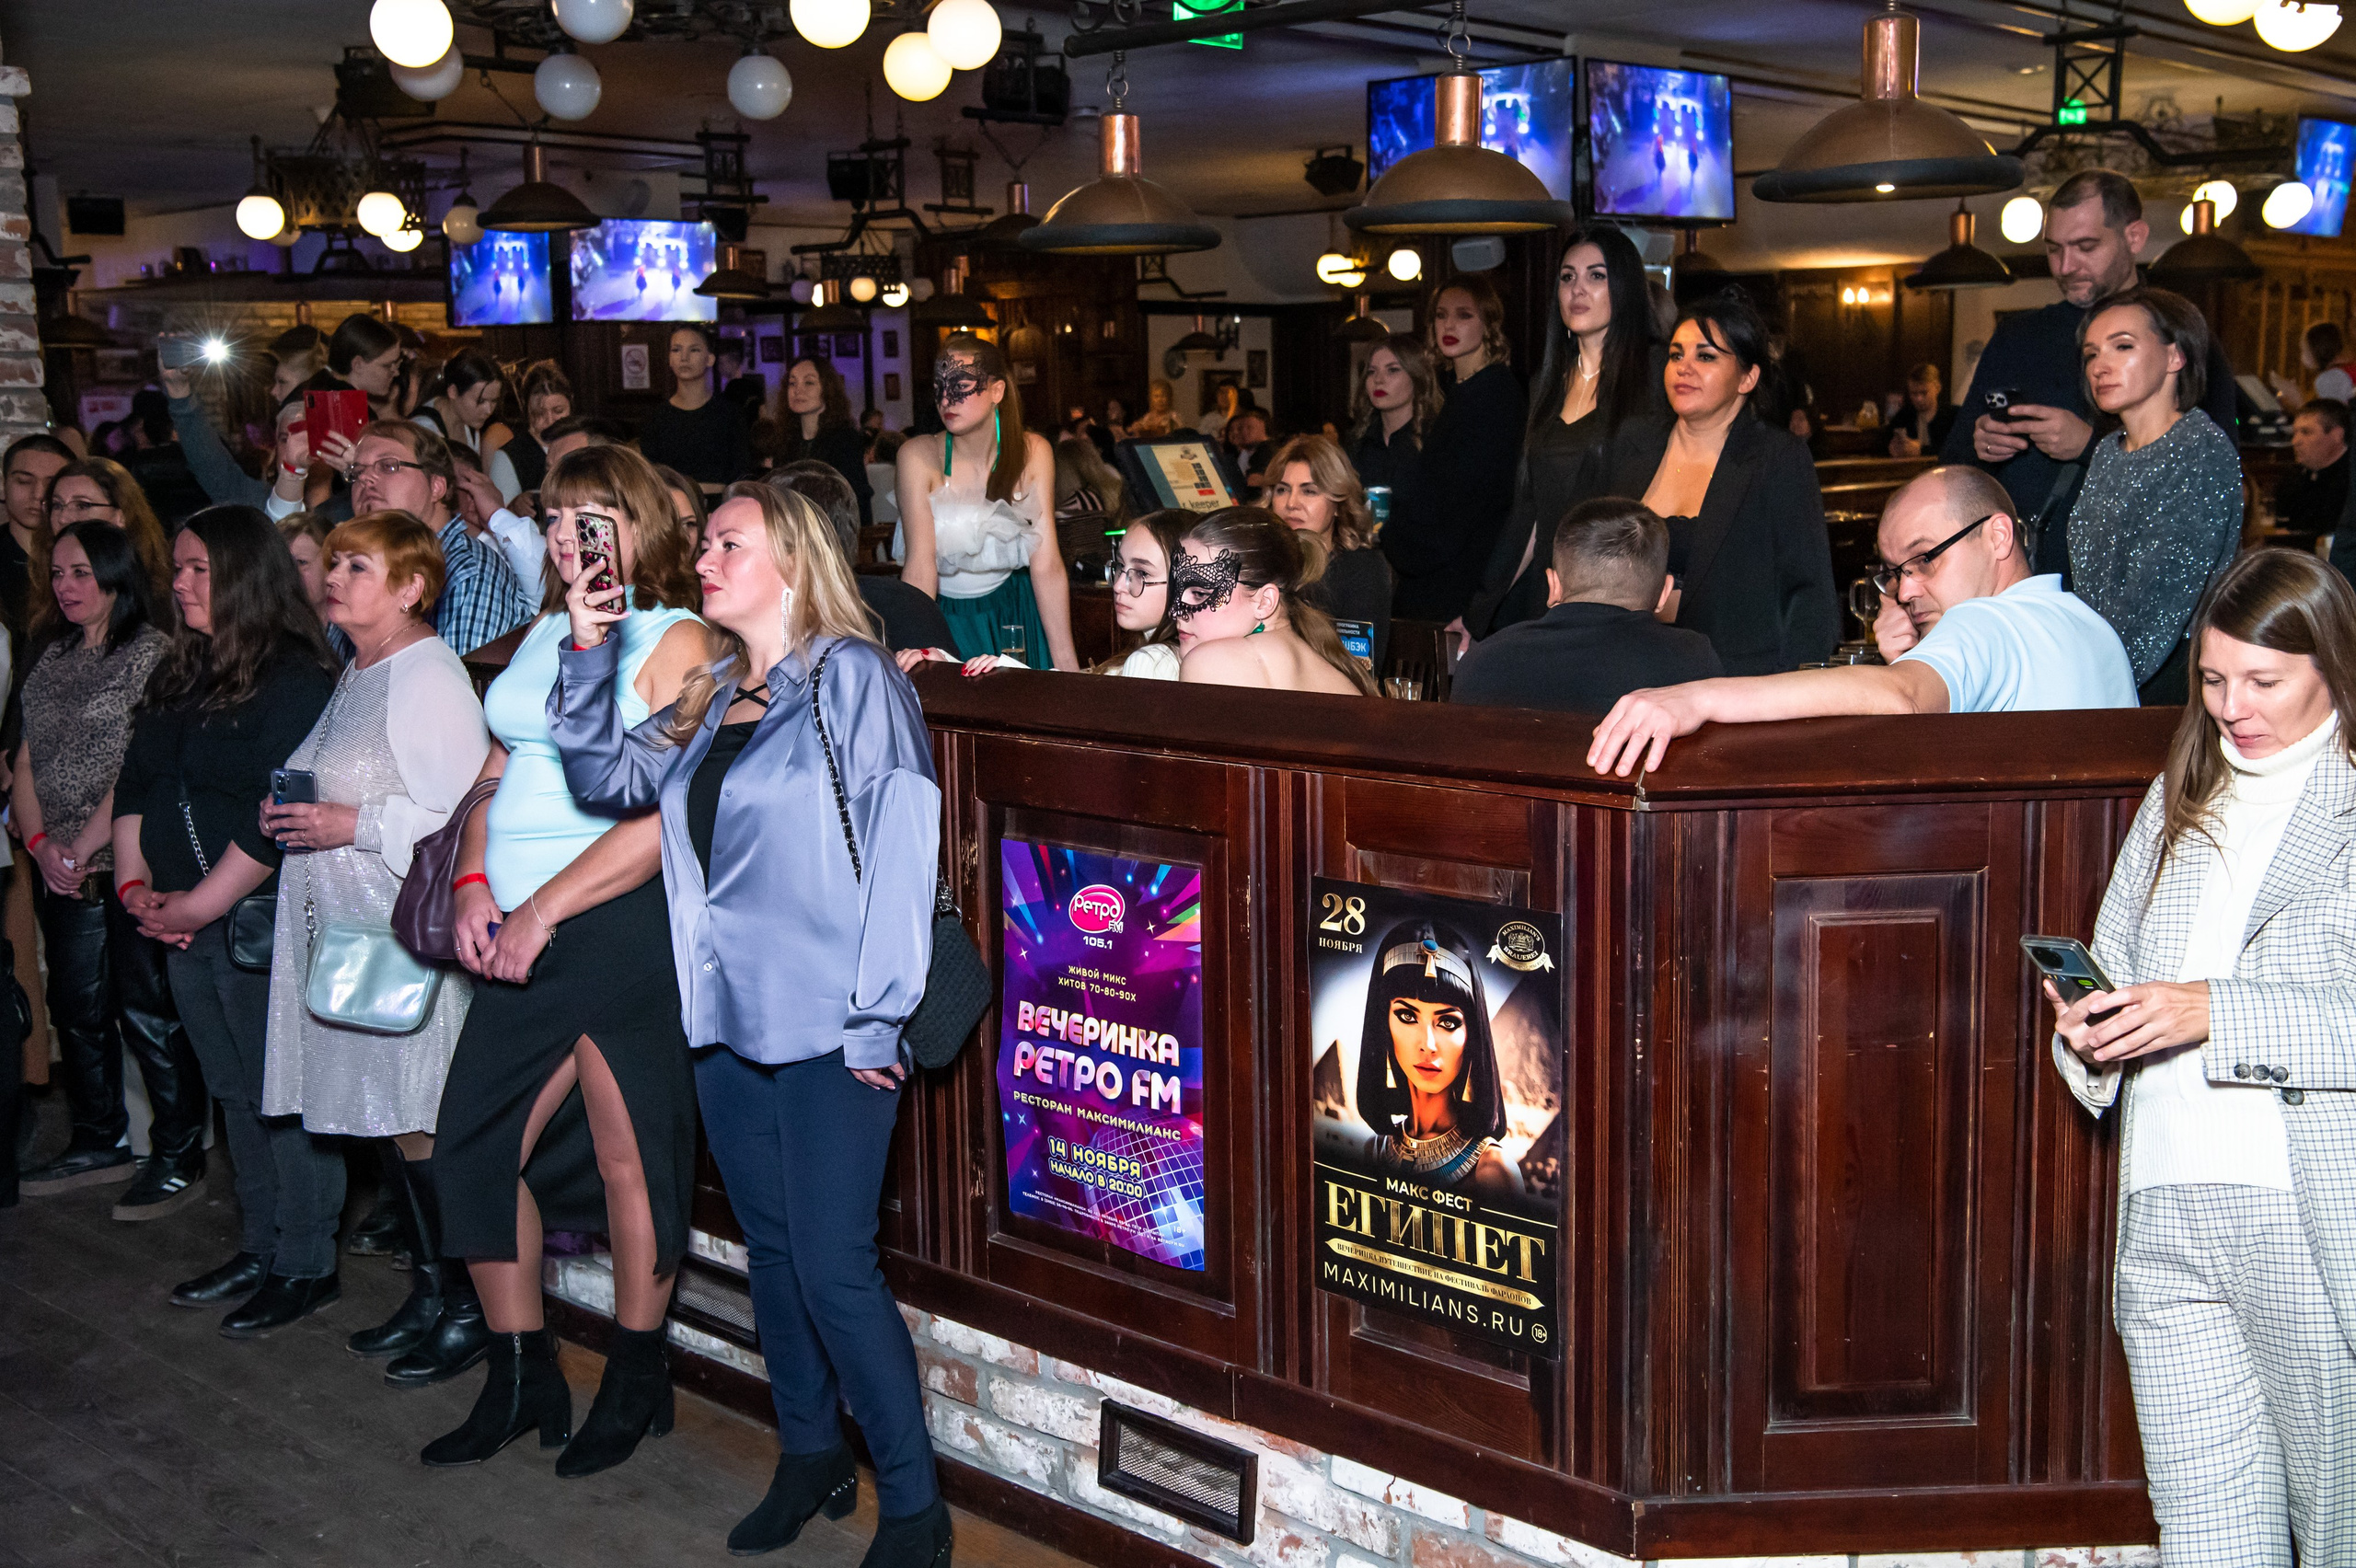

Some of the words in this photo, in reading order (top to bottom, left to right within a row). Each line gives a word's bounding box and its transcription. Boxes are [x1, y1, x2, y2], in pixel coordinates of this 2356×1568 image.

[1320, 893, 1366, 936] 28
[1083, 936, 1113, 950] 105.1
[1319, 937, 1363, 954] НОЯБРЯ
[1503, 946, 1539, 961] BRAUEREI
[1058, 976, 1086, 990] ХИТОВ
[1068, 965, 1100, 979] ЖИВОЙ
[1103, 972, 1126, 986] МИКС
[1017, 1000, 1180, 1066] ВЕЧЕРИНКА
[1013, 1041, 1123, 1100] РЕТРО
[1131, 1069, 1182, 1114] FM
[1013, 1090, 1073, 1115] РЕСТОРАН
[1077, 1107, 1182, 1141] МАКСИМИЛИАНС
[1049, 1138, 1066, 1158] 14
[1072, 1145, 1141, 1179] НОЯБРЯ
[1050, 1159, 1094, 1184] НАЧАЛО
[1097, 1174, 1106, 1187] В
[1108, 1178, 1143, 1198] 20:00
[1386, 1177, 1428, 1200] МАКС
[1432, 1190, 1472, 1212] ФЕСТ
[1324, 1180, 1545, 1283] ЕГИПЕТ
[1323, 1261, 1524, 1336] MAXIMILIANS.RU
[1434, 1271, 1444, 1281] НА
[1445, 1274, 1490, 1293] ФЕСТИВАЛЬ
[1490, 1287, 1531, 1305] ФАРАОНОВ
[1535, 1327, 1546, 1339] 18+
